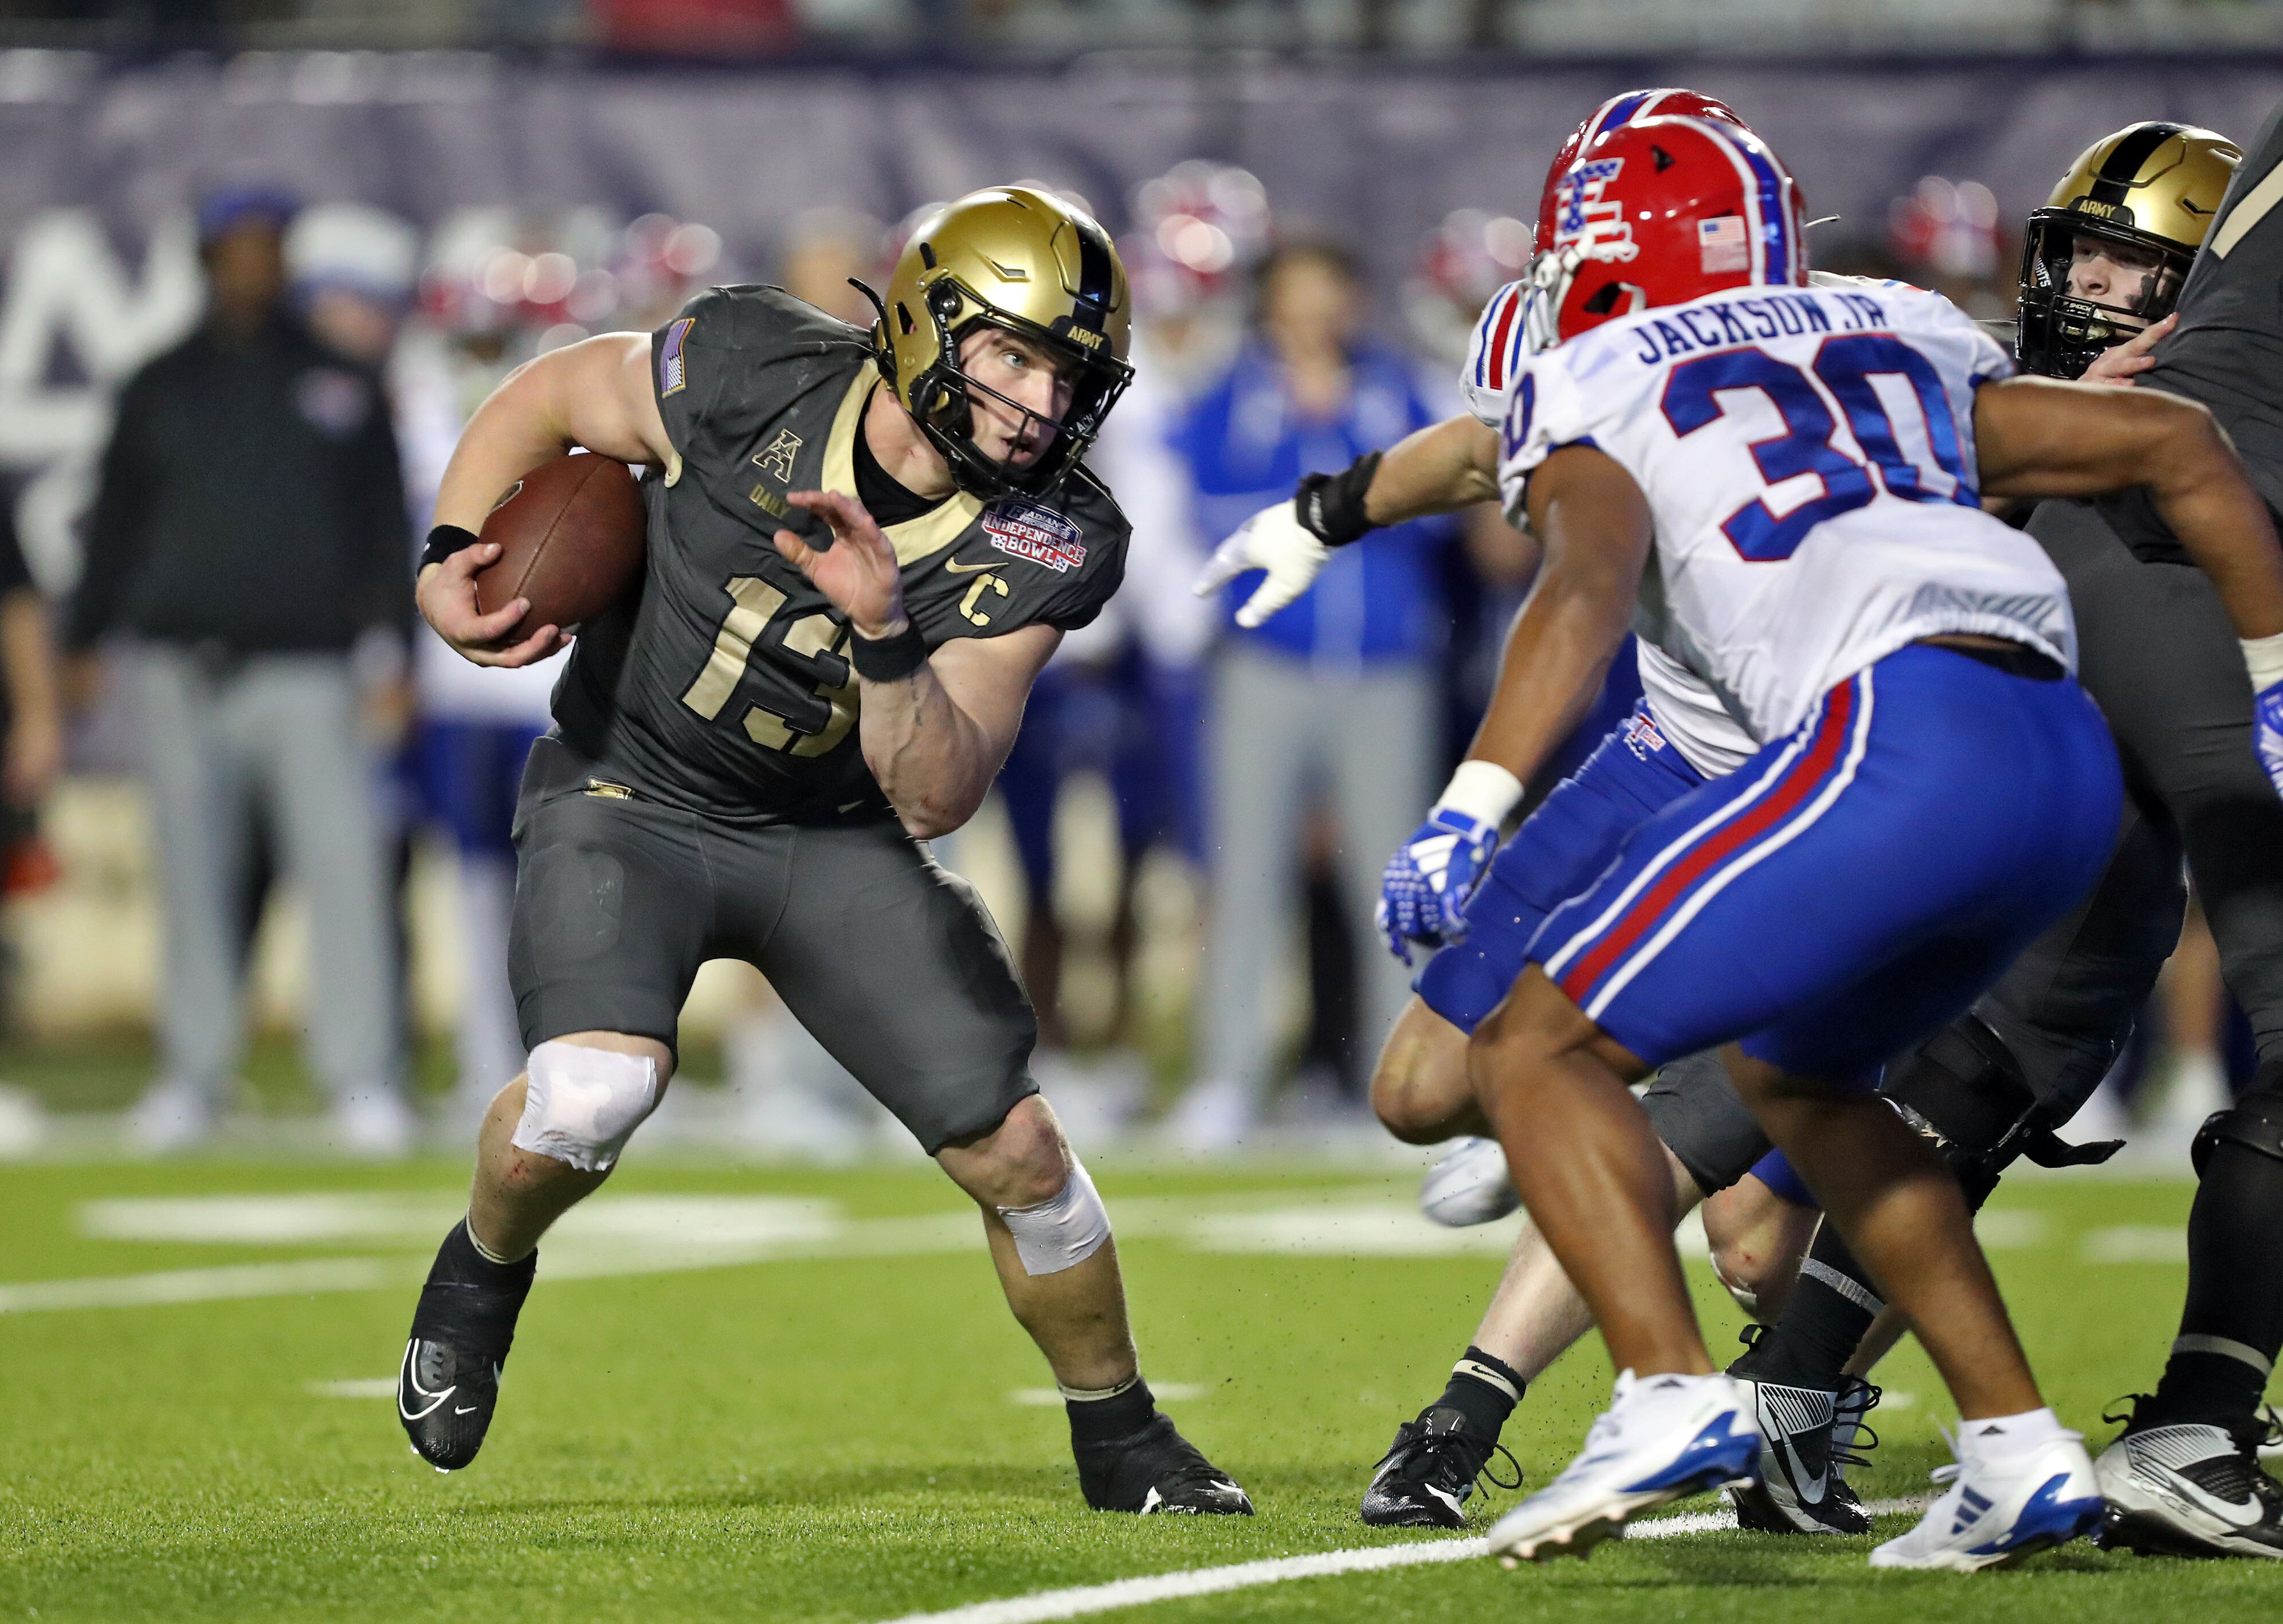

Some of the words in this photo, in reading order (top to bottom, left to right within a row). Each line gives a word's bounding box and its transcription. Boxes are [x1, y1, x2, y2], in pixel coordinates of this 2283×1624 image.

[2077, 199, 2117, 218] ARMY
[1067, 325, 1104, 350] ARMY
[1633, 293, 1832, 364] JACKSON
[1834, 294, 1888, 329] JR
[1660, 331, 1981, 563] 30
[983, 512, 1087, 563] INDEPENDENCE
[1006, 535, 1054, 563] BOWL
[959, 572, 1010, 626] C
[681, 576, 861, 758] 13
